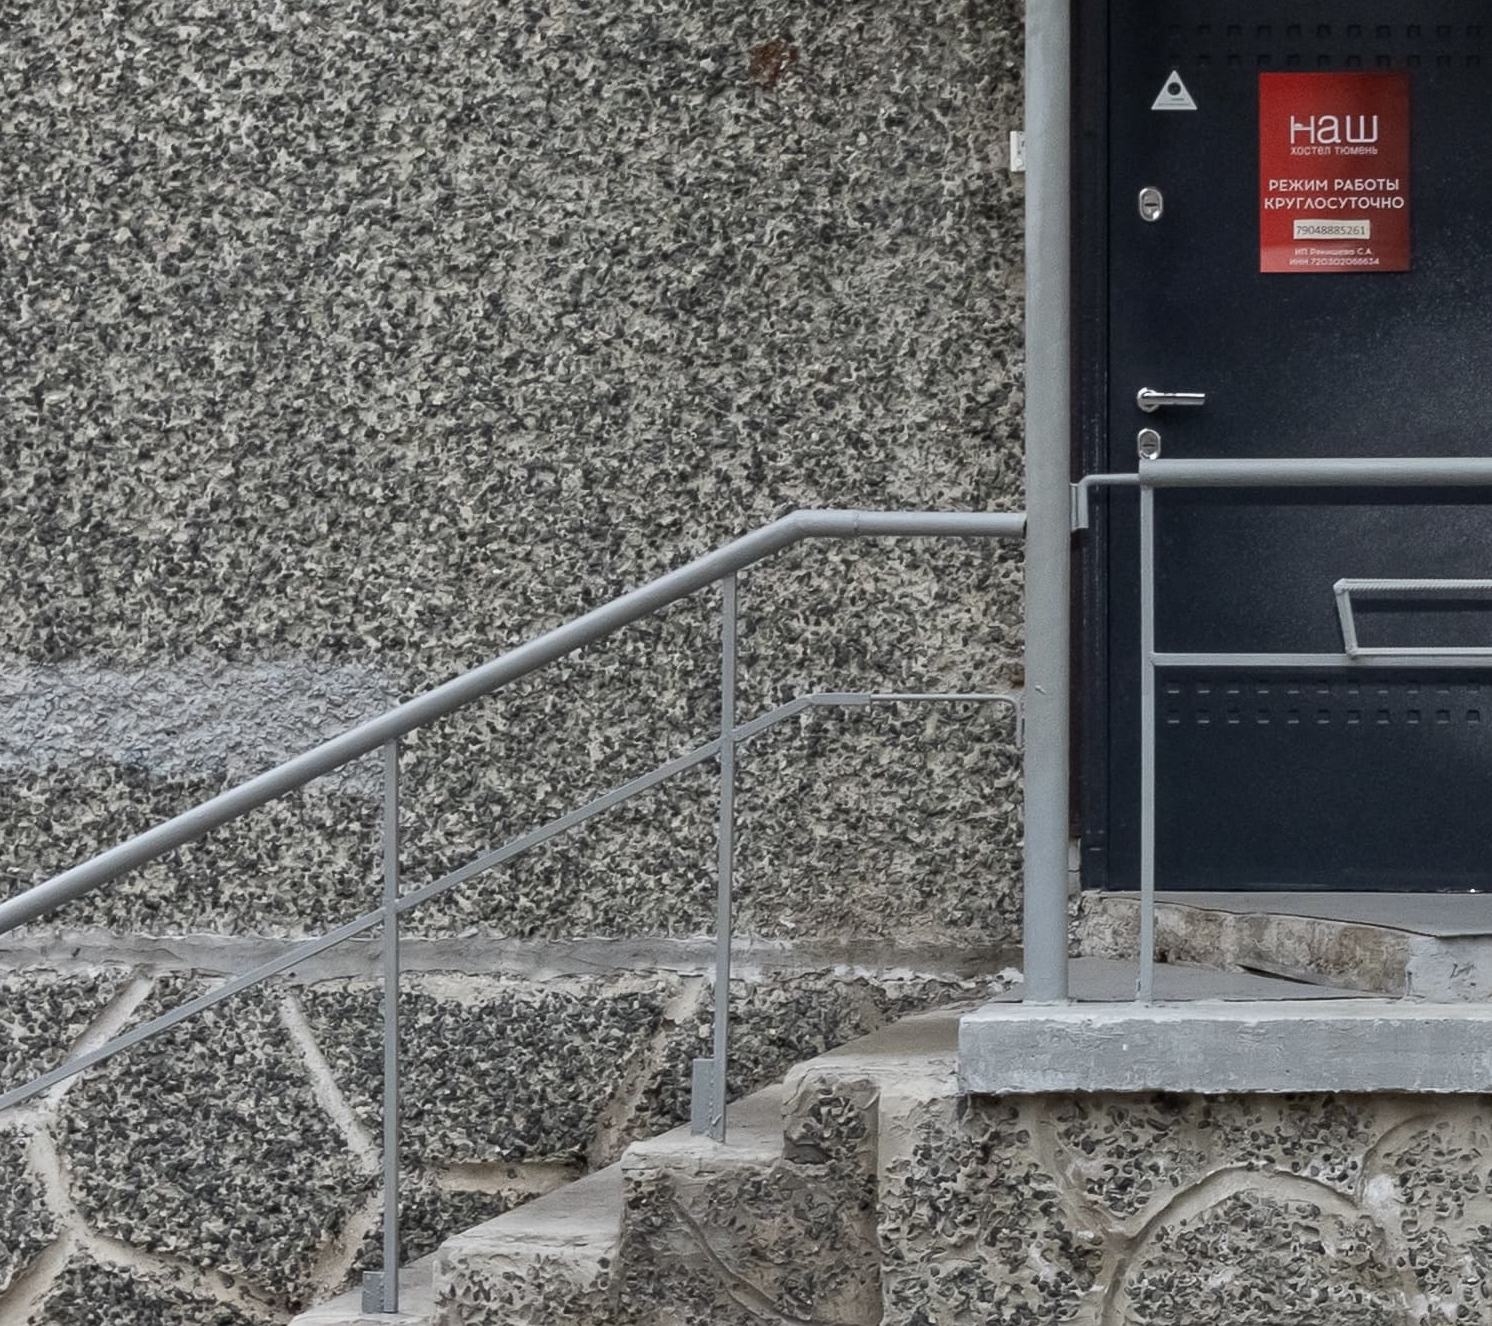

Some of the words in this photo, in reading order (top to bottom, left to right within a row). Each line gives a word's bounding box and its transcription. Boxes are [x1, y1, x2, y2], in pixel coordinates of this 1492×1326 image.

[1290, 146, 1331, 155] хостел
[1334, 145, 1378, 155] тюмень
[1268, 179, 1328, 192] РЕЖИМ
[1334, 178, 1399, 191] РАБОТЫ
[1264, 196, 1404, 210] КРУГЛОСУТОЧНО
[1296, 225, 1366, 236] 79048885261
